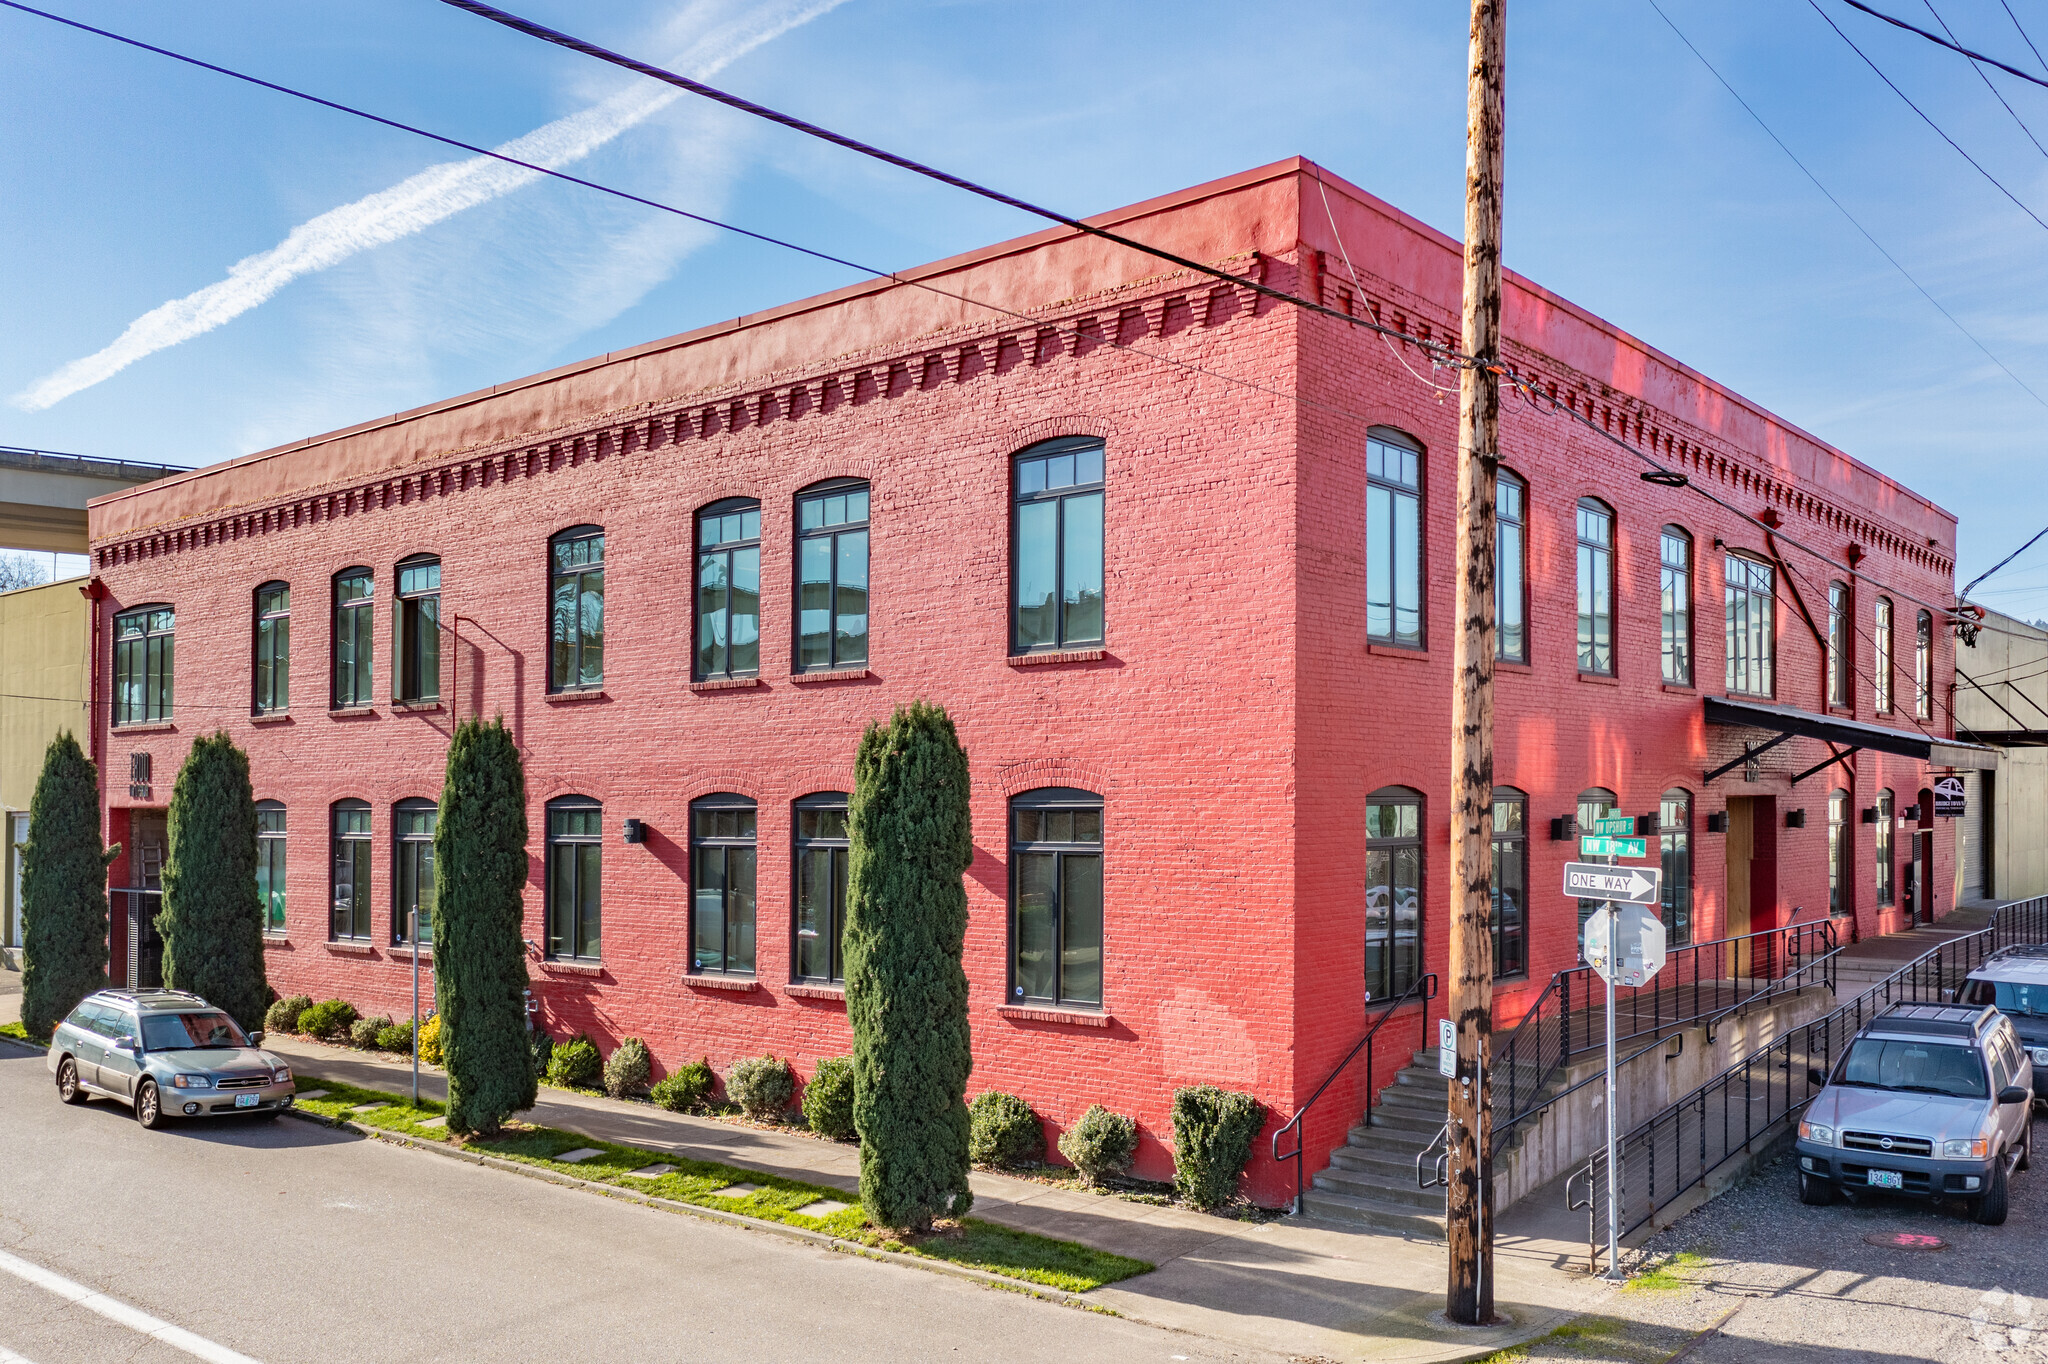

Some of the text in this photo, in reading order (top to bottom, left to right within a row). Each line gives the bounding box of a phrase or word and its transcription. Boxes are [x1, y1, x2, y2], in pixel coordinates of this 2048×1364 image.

[1596, 822, 1604, 834] NW
[1606, 820, 1626, 834] UPSHUR
[1586, 839, 1600, 852] NW
[1627, 841, 1639, 854] AV
[1571, 873, 1631, 891] ONE WAY
[1445, 1028, 1452, 1043] P
[1870, 1173, 1882, 1182] 134
